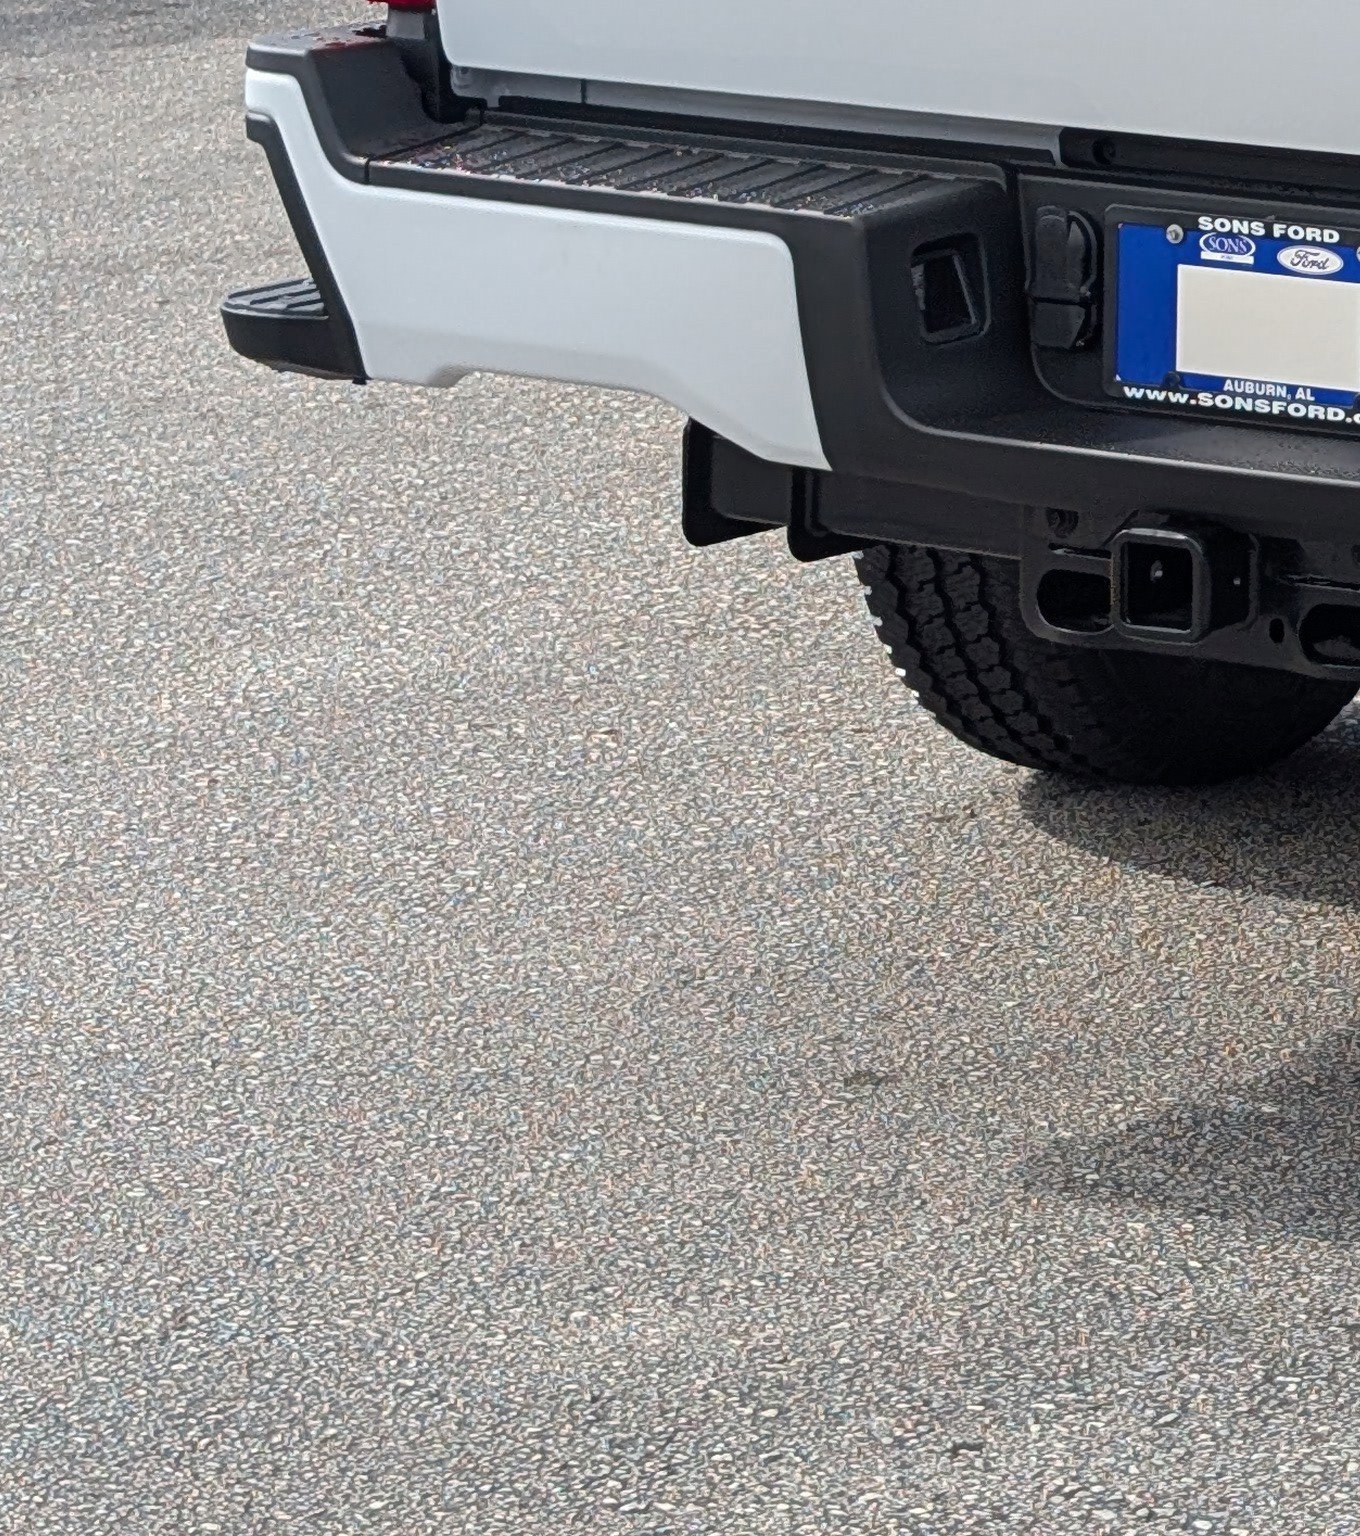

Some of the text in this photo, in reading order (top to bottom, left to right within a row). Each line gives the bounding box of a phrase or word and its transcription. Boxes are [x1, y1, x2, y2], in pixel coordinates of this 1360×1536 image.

[1197, 216, 1341, 244] SONS FORD
[1207, 235, 1248, 253] SONS
[1290, 249, 1330, 270] Ford
[1223, 378, 1316, 402] AUBURN, AL
